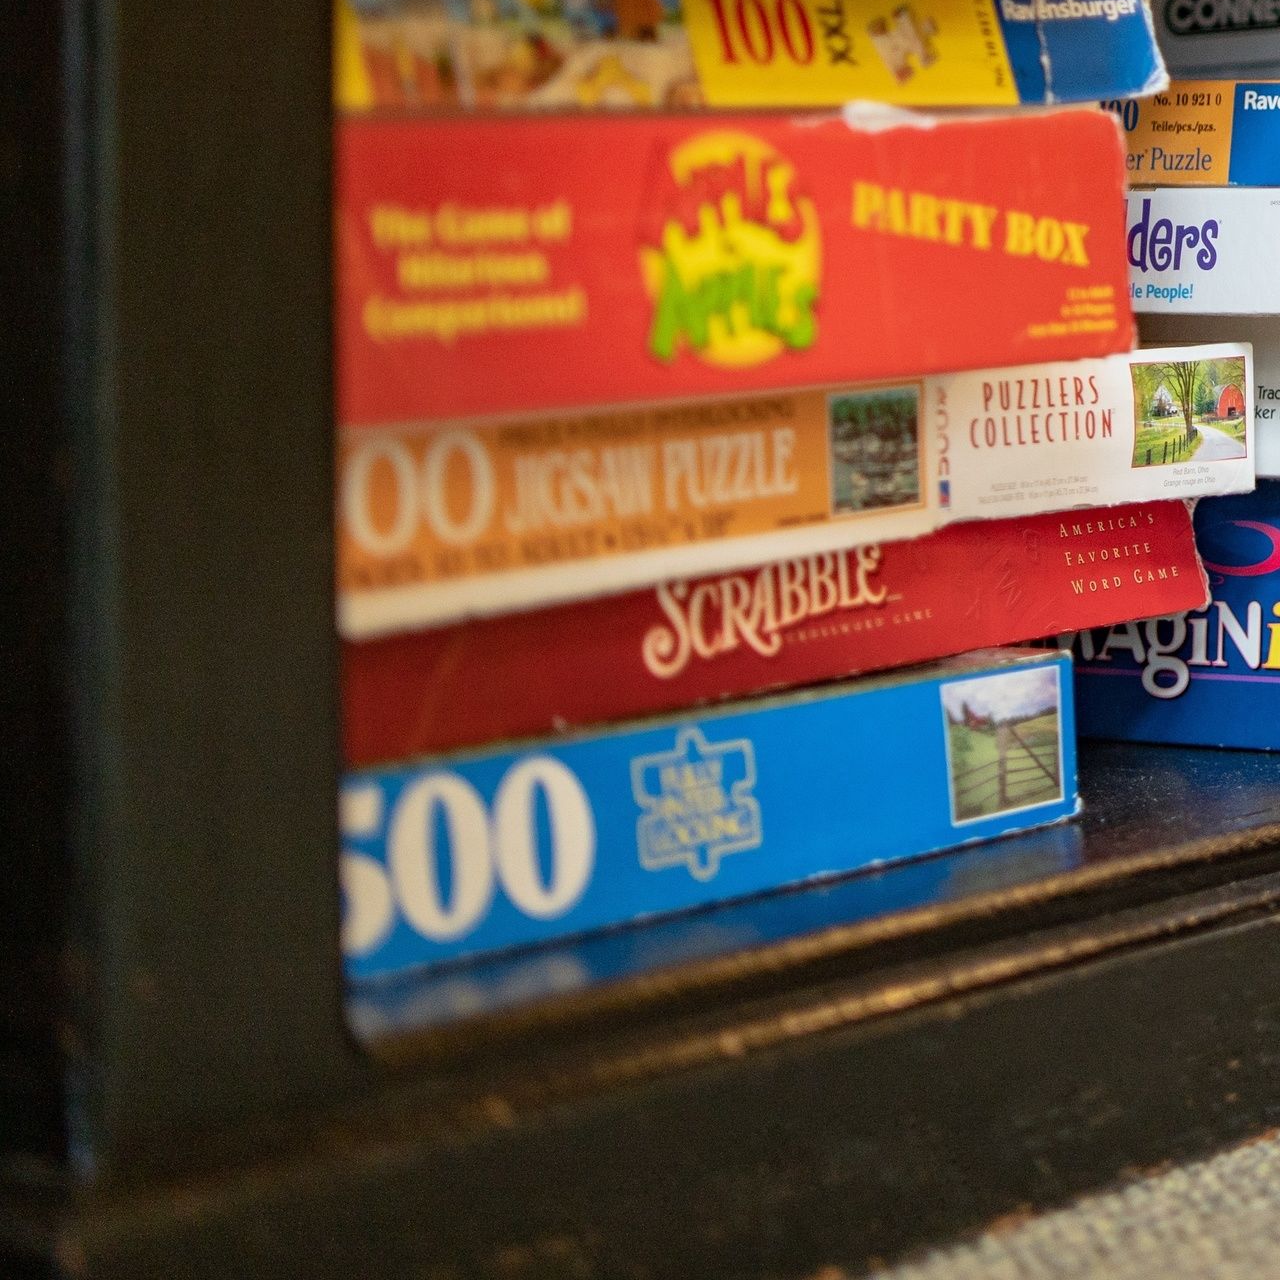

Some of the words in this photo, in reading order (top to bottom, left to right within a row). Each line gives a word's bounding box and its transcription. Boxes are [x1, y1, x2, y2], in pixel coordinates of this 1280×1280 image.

[1153, 94, 1171, 107] No.
[1175, 93, 1190, 107] 10
[1191, 93, 1213, 107] 921
[1214, 93, 1222, 106] 0
[1151, 121, 1217, 133] Teile/pcs./pzs.
[1150, 148, 1212, 171] Puzzle
[852, 180, 997, 251] PARTY
[1004, 210, 1091, 267] BOX
[1145, 284, 1194, 303] People!
[982, 375, 1100, 413] PUZZLERS
[969, 408, 1113, 449] COLLECTION
[504, 443, 656, 534] JIGSAW
[662, 428, 797, 512] PUZZLE
[1059, 512, 1154, 538] AMERICA'S
[1065, 542, 1151, 567] FAVORITE
[1071, 576, 1122, 596] WORD
[1133, 566, 1179, 585] GAME
[642, 542, 892, 681] SCRABBLE
